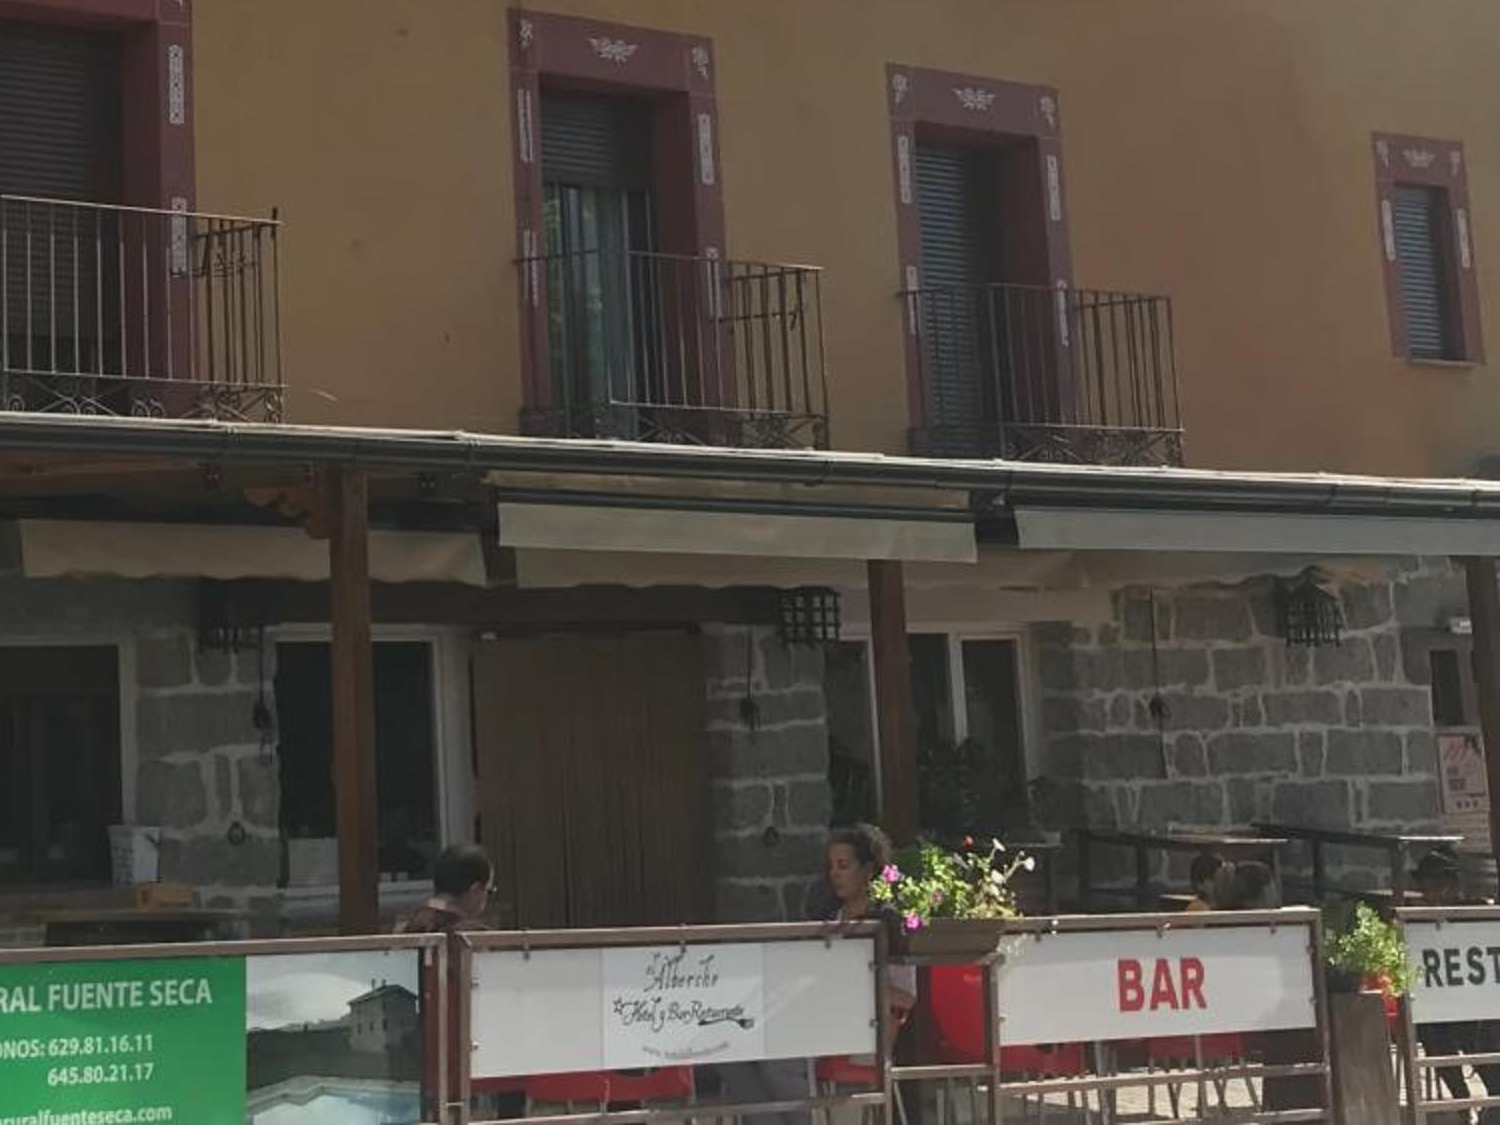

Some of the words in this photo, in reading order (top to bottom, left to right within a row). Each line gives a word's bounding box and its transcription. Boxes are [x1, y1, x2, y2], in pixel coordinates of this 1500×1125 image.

[1422, 946, 1500, 987] REST
[49, 981, 143, 1011] FUENTE
[149, 978, 213, 1006] SECA
[1117, 957, 1208, 1012] BAR
[48, 1034, 153, 1057] 629.81.16.11
[47, 1062, 154, 1087] 645.80.21.17
